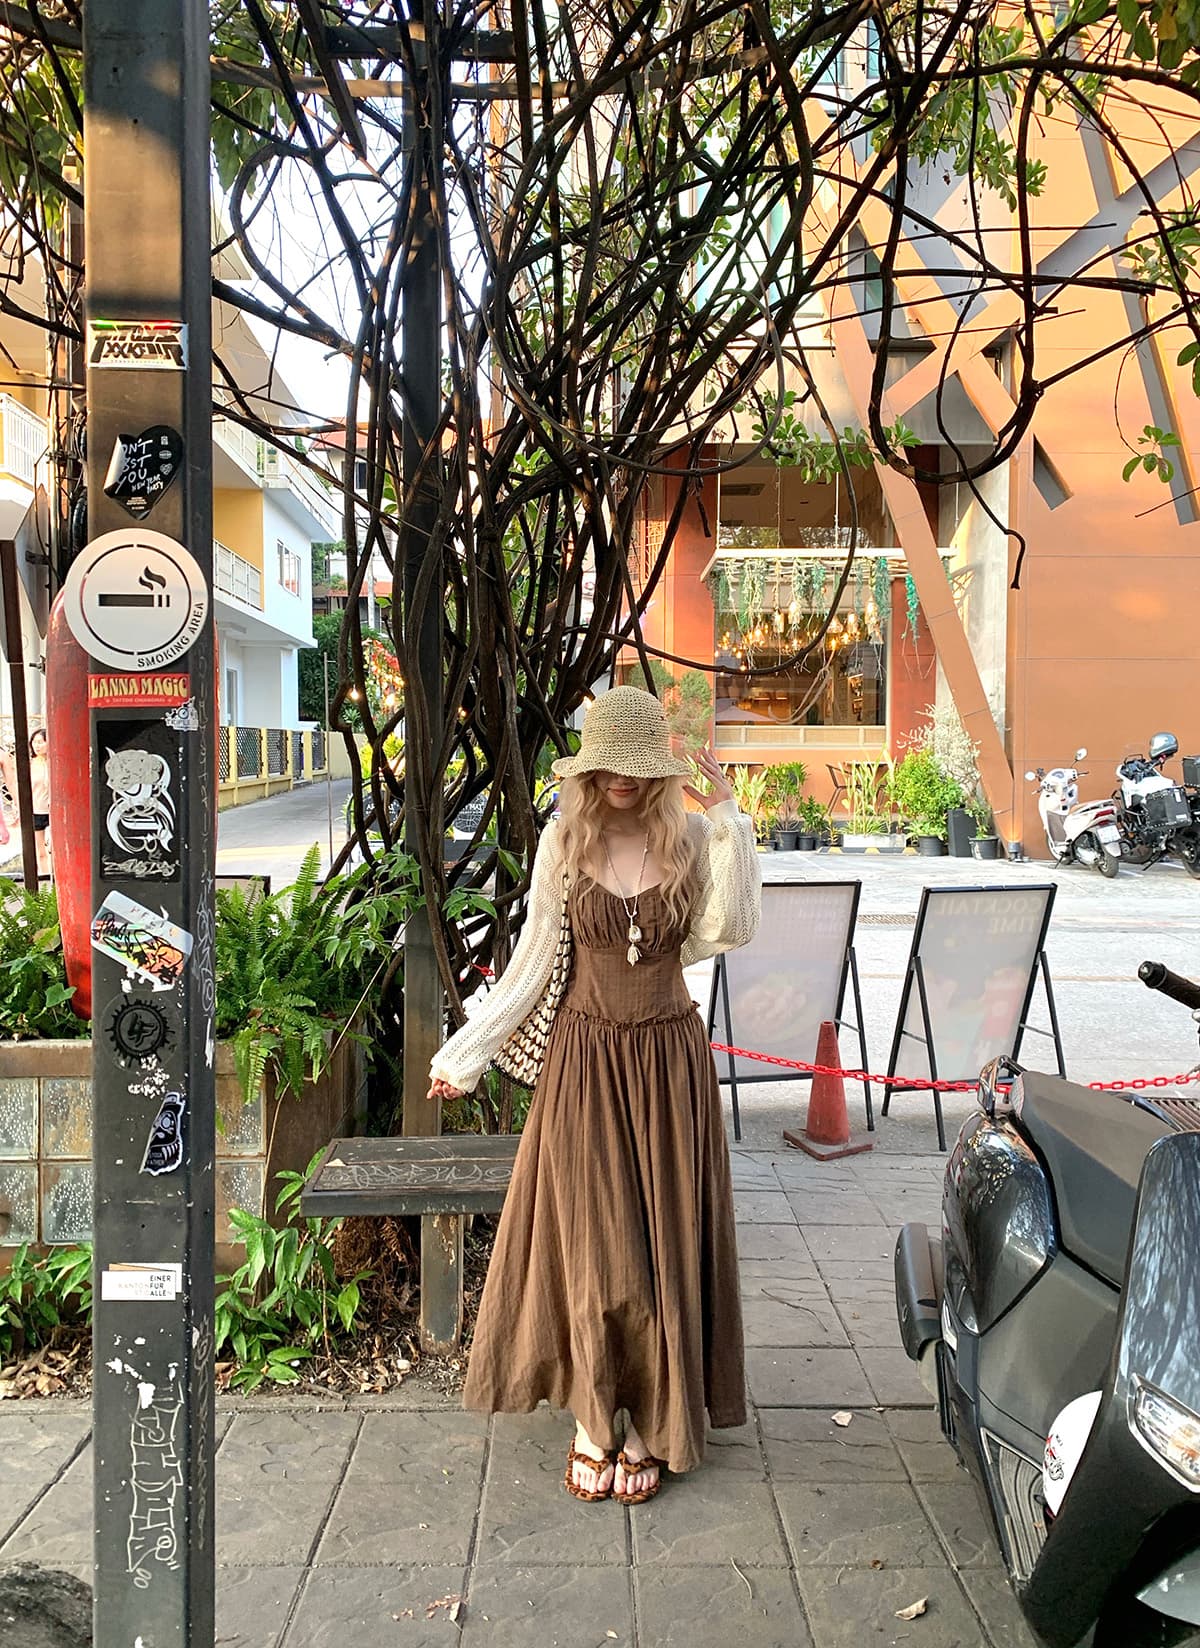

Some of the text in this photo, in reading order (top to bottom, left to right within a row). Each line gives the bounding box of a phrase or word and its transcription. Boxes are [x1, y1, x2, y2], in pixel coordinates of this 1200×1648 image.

[137, 602, 205, 668] SMOKING AREA
[90, 677, 137, 699] LANNA
[149, 1274, 171, 1282] EINER
